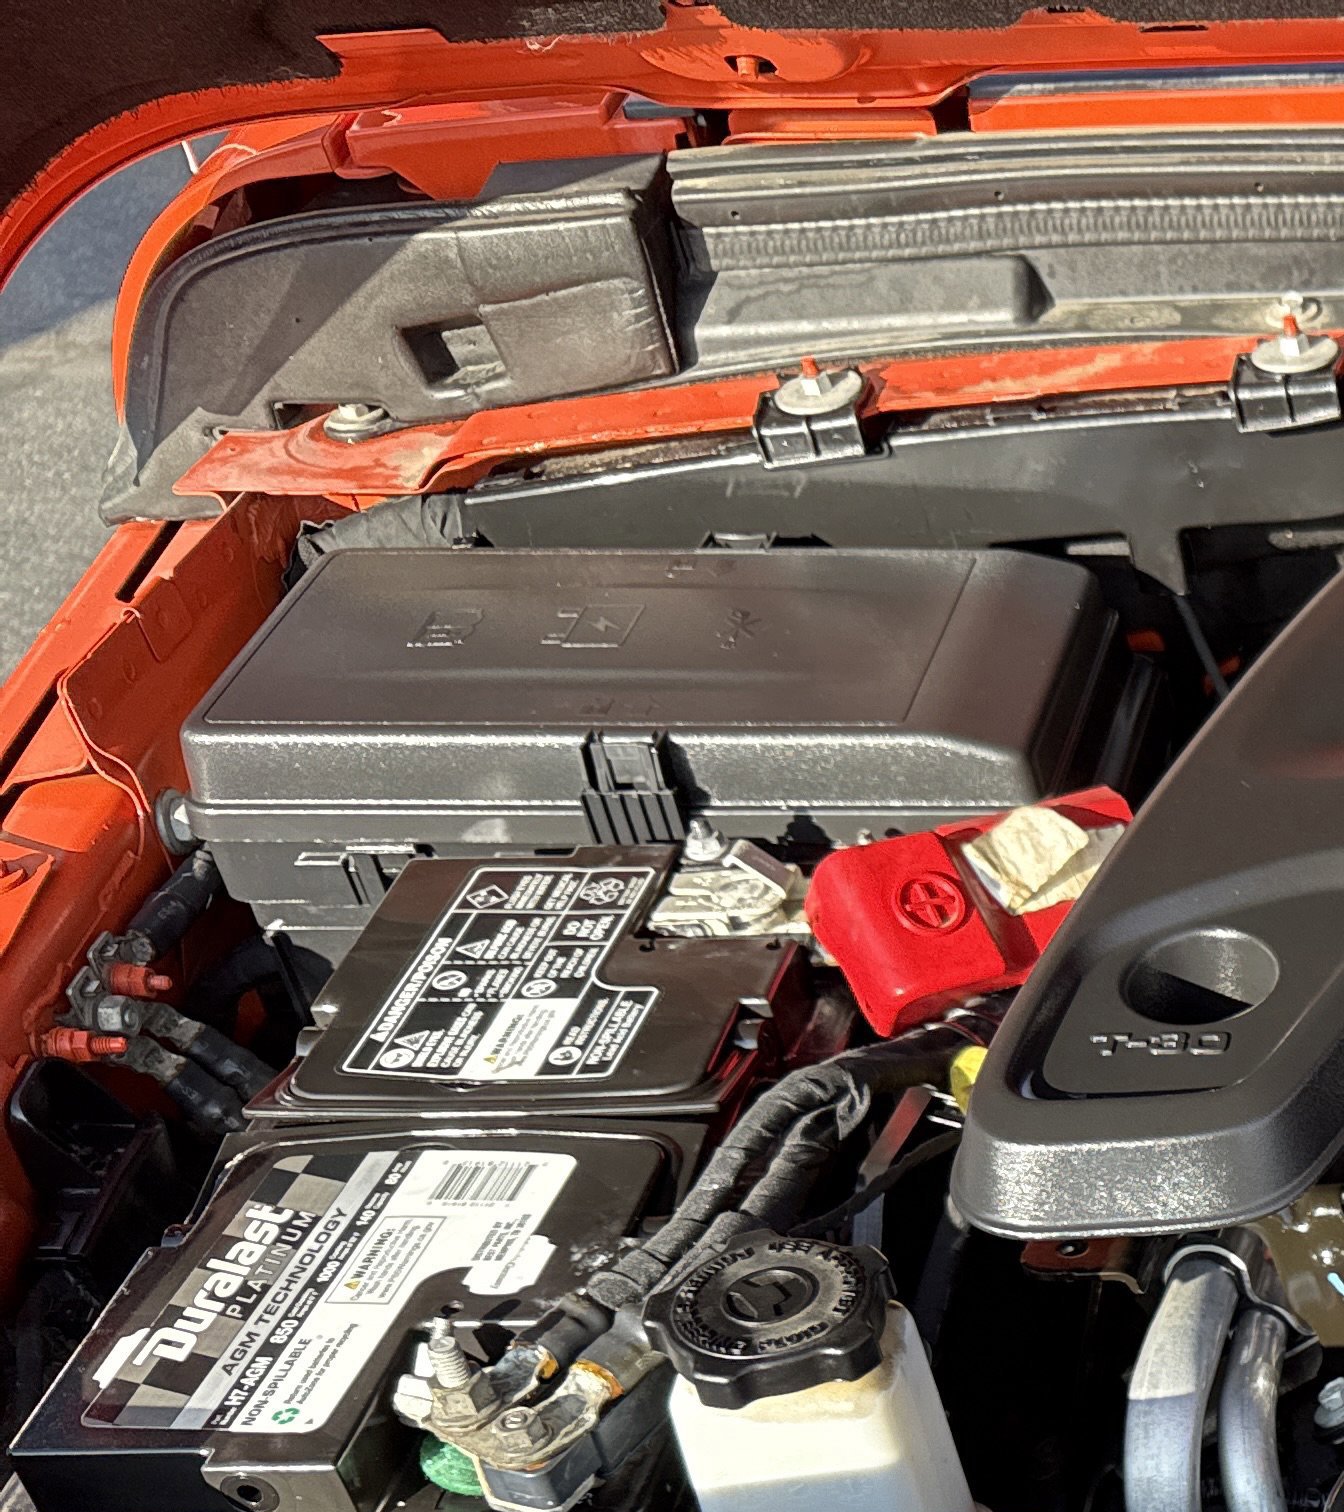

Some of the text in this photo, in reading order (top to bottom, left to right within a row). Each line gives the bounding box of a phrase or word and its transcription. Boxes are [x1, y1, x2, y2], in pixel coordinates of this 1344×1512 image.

[561, 920, 582, 935] DO
[575, 918, 598, 936] NOT
[382, 1172, 404, 1184] 80
[353, 1209, 378, 1225] 140
[225, 1211, 317, 1319] PLATINUM
[313, 1260, 342, 1282] 1000
[349, 1228, 396, 1278] WARNING:
[132, 1203, 294, 1363] Duralast
[220, 1207, 350, 1375] AGM TECHNOLOGY
[267, 1319, 301, 1343] 850
[222, 1356, 274, 1405] H7-AGM
[240, 1338, 312, 1425] NON-SPILLABLE
